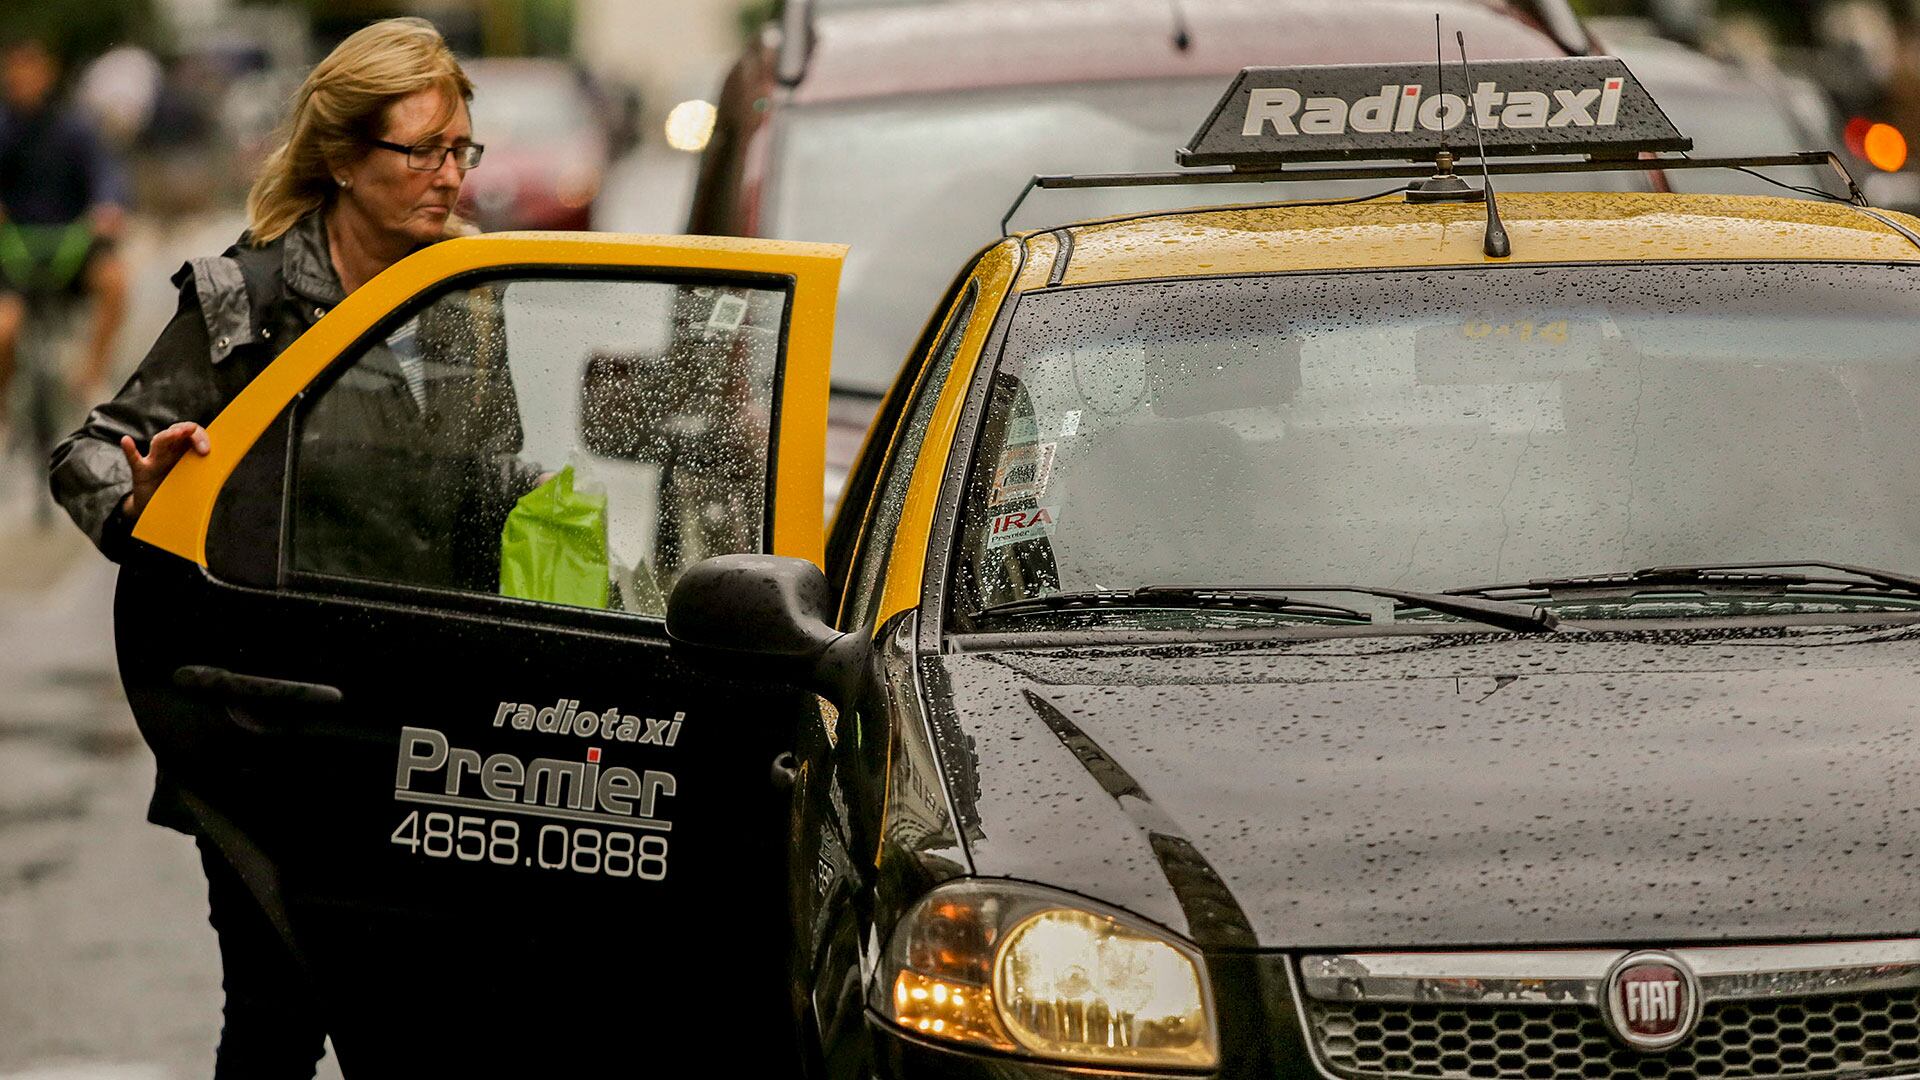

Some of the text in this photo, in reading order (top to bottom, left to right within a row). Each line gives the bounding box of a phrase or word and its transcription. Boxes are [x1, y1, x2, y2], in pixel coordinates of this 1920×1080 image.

[1241, 77, 1624, 136] Radiotaxi
[993, 507, 1052, 535] IRA
[493, 698, 686, 747] radiotaxi
[395, 726, 677, 818] Premier
[391, 810, 668, 881] 4858.0888
[1625, 980, 1681, 1022] FIAT
